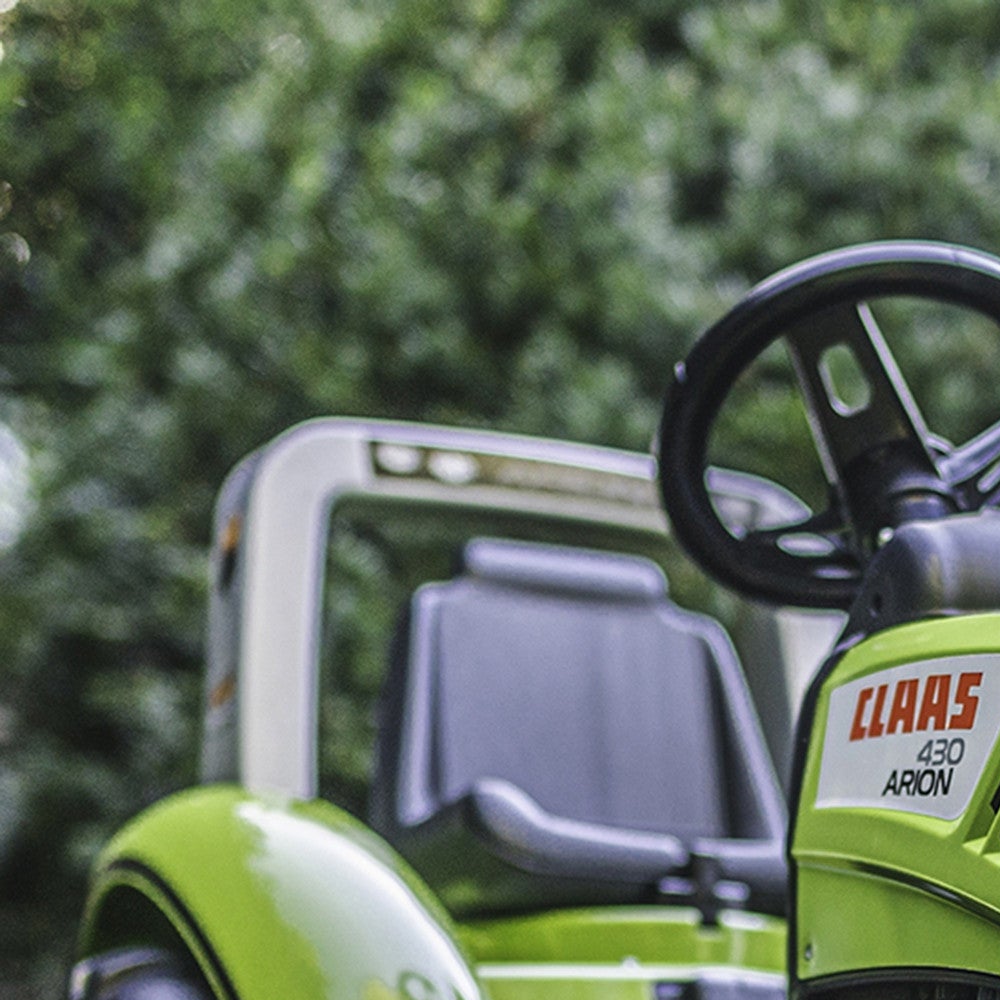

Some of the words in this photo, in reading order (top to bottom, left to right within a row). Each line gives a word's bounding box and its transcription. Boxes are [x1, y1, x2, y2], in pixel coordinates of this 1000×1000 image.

[849, 672, 984, 742] CLAAS
[916, 737, 966, 766] 430
[881, 767, 954, 797] ARION
